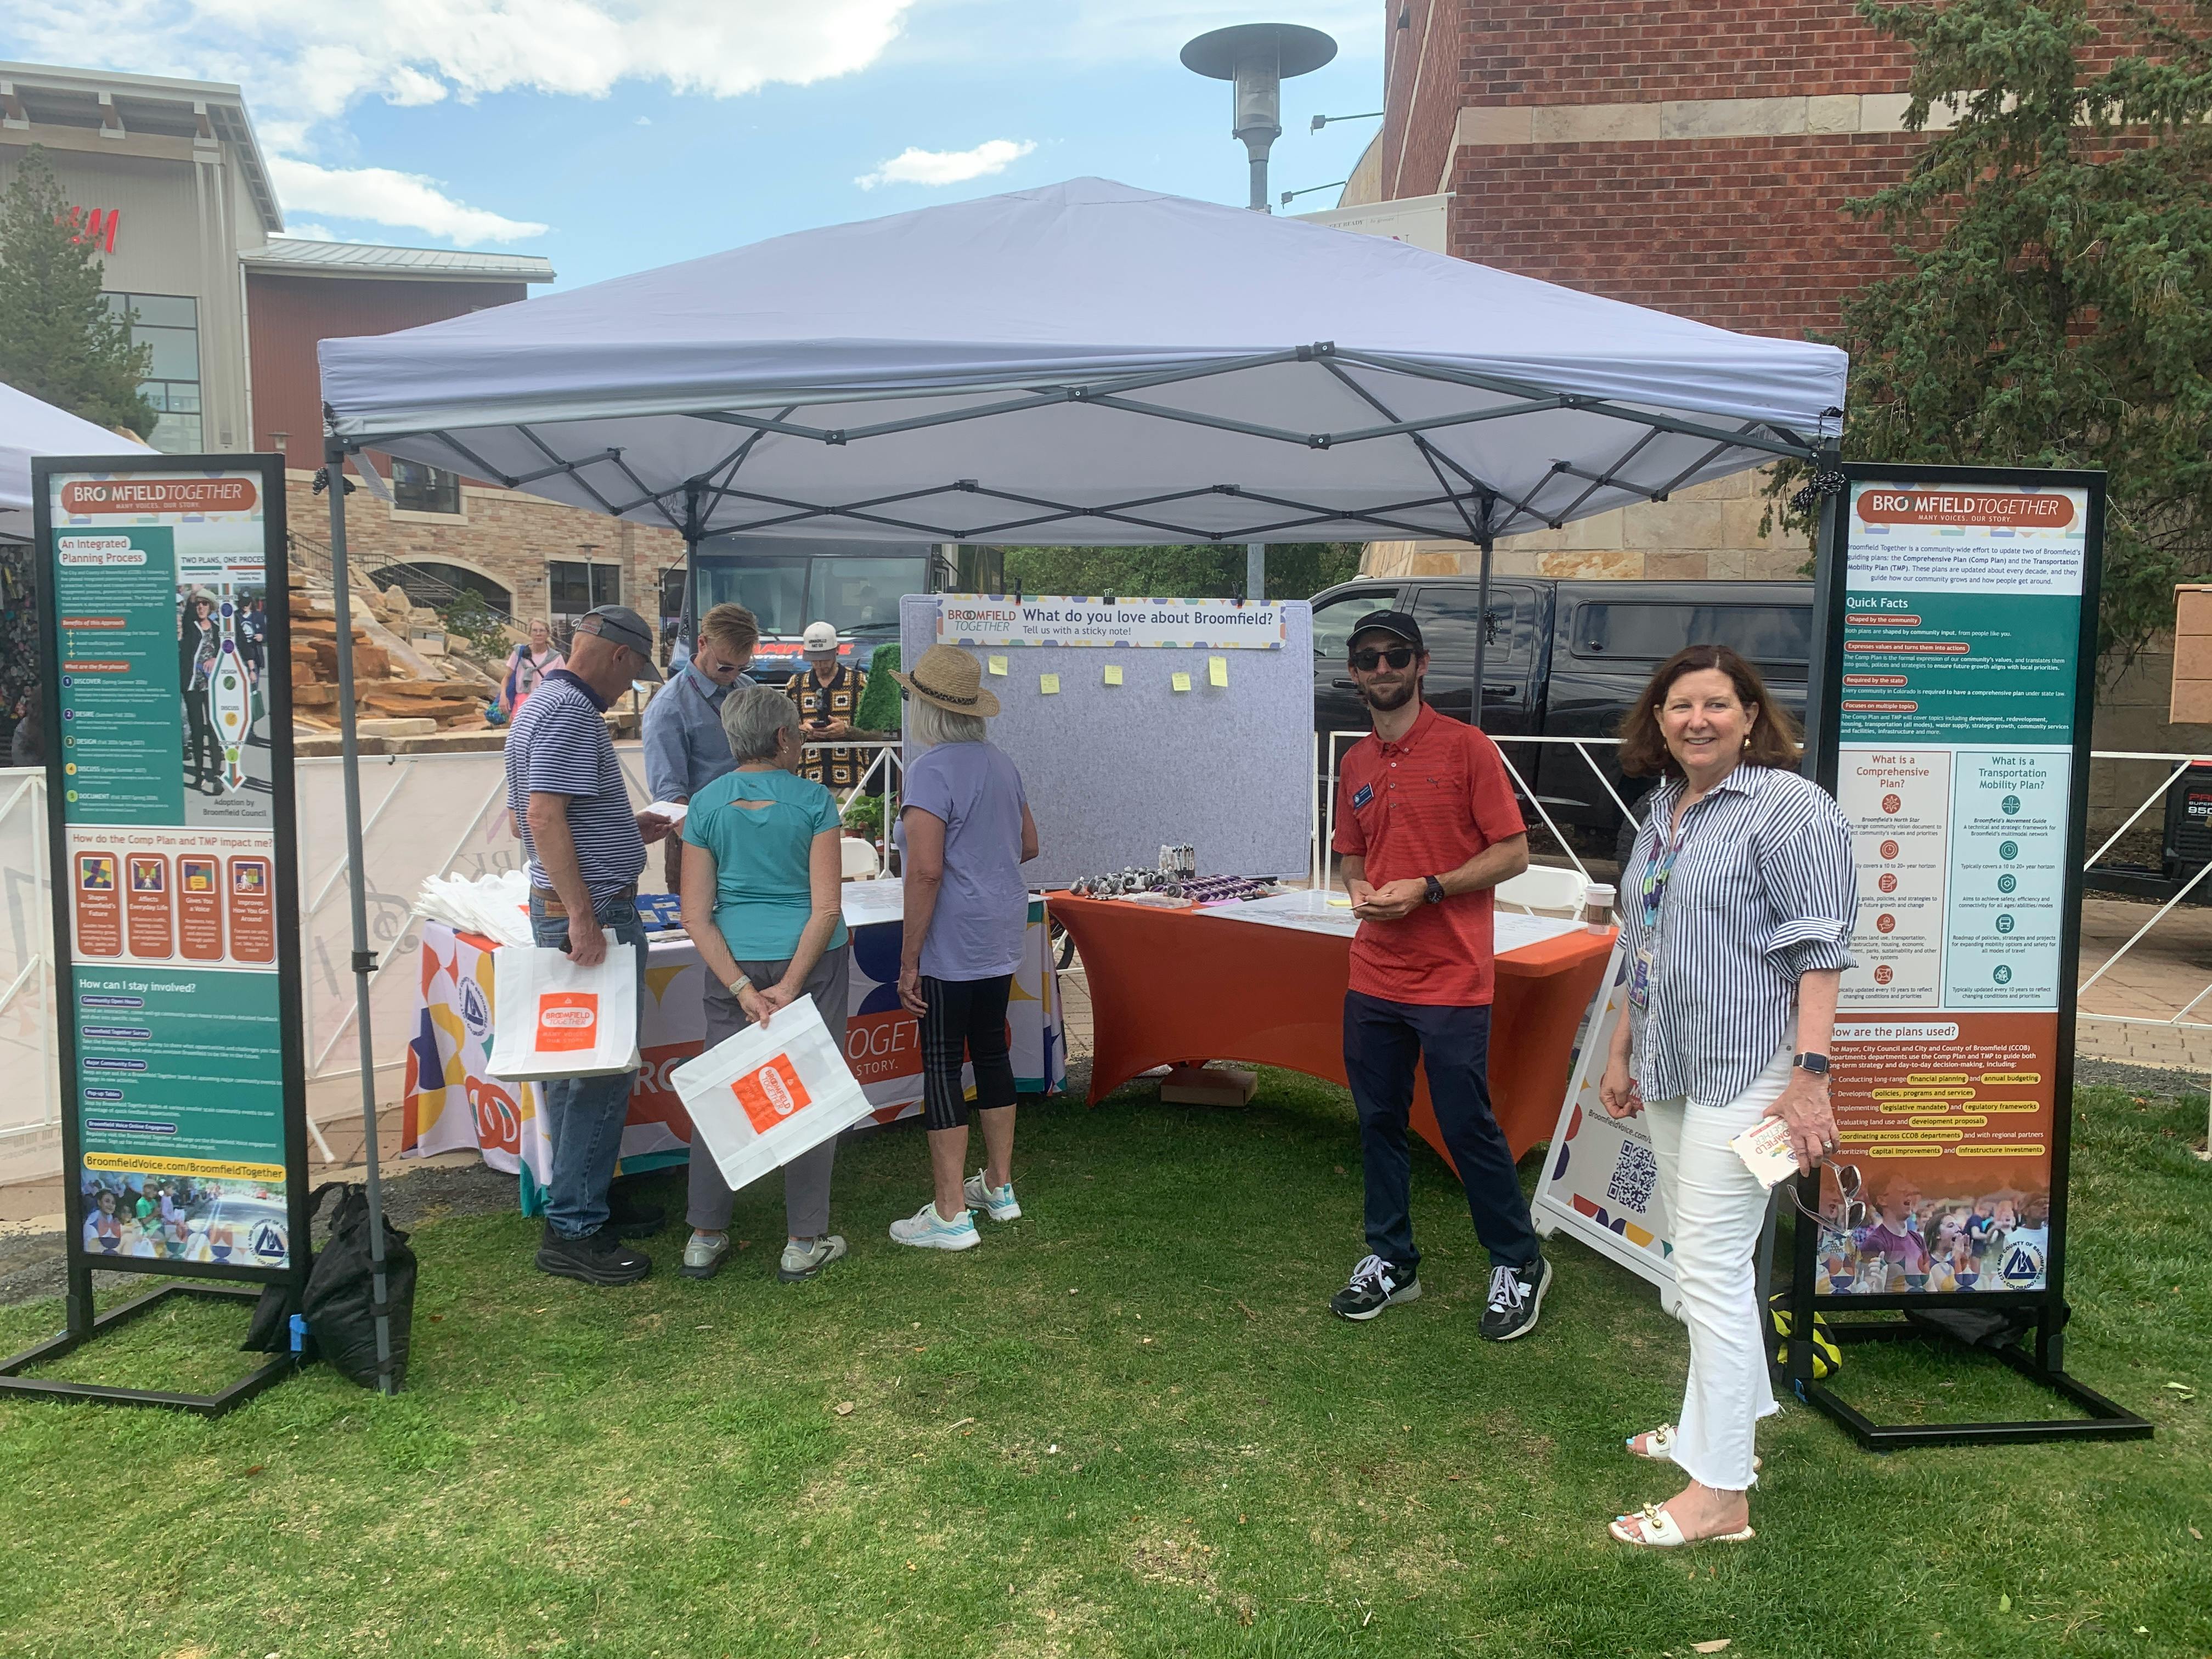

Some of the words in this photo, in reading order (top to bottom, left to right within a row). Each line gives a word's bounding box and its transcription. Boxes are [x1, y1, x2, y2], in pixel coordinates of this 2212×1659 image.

[61, 540, 74, 548] An
[77, 539, 126, 550] Integrated
[1880, 544, 1907, 552] Together
[1920, 545, 1971, 554] community-wide
[62, 553, 103, 565] Planning
[106, 552, 143, 562] Process
[239, 555, 264, 564] PROCES
[1846, 597, 1877, 608] Quick
[1880, 597, 1908, 608] Facts
[948, 610, 1016, 621] BROOMFIELD
[1023, 608, 1059, 621] What
[1065, 609, 1082, 622] do
[1087, 613, 1111, 625] you
[1118, 610, 1146, 623] love
[1150, 611, 1189, 623] about
[1194, 612, 1272, 624] Broomfield?
[955, 621, 1010, 631] TOGETHER
[1023, 625, 1038, 634] Tell
[1052, 626, 1071, 634] with
[1082, 627, 1107, 636] sticky
[1872, 755, 1896, 764] What
[1899, 755, 1906, 764] is
[1991, 756, 2016, 765] What
[2019, 757, 2026, 765] is
[1857, 766, 1929, 777] Comprehensive
[1978, 768, 2046, 779] Transportation
[1880, 779, 1904, 787] Plan?
[1979, 780, 2017, 791] Mobility
[2020, 781, 2044, 789] Plan?
[73, 834, 93, 843] How
[95, 834, 107, 843] do
[109, 835, 125, 843] the
[128, 834, 154, 845] Comp
[156, 836, 176, 844] Plan
[178, 836, 195, 845] and
[198, 837, 217, 845] TMP
[220, 837, 251, 848] impact
[254, 837, 273, 847] me?
[79, 979, 100, 988] How
[122, 980, 126, 989] I
[128, 981, 148, 992] stay
[150, 981, 196, 992] involved?
[1833, 1027, 1850, 1036] ow
[1875, 1026, 1892, 1036] the
[1895, 1026, 1922, 1037] plans
[1926, 1026, 1955, 1036] used?
[846, 1019, 919, 1059] OGET
[856, 1059, 898, 1076] STORY.
[1756, 1120, 1788, 1146] OGETHER
[87, 1156, 283, 1178] BroomfieldVoice.com/BroomfieldTogether
[2006, 1282, 2034, 1290] COLORADO
